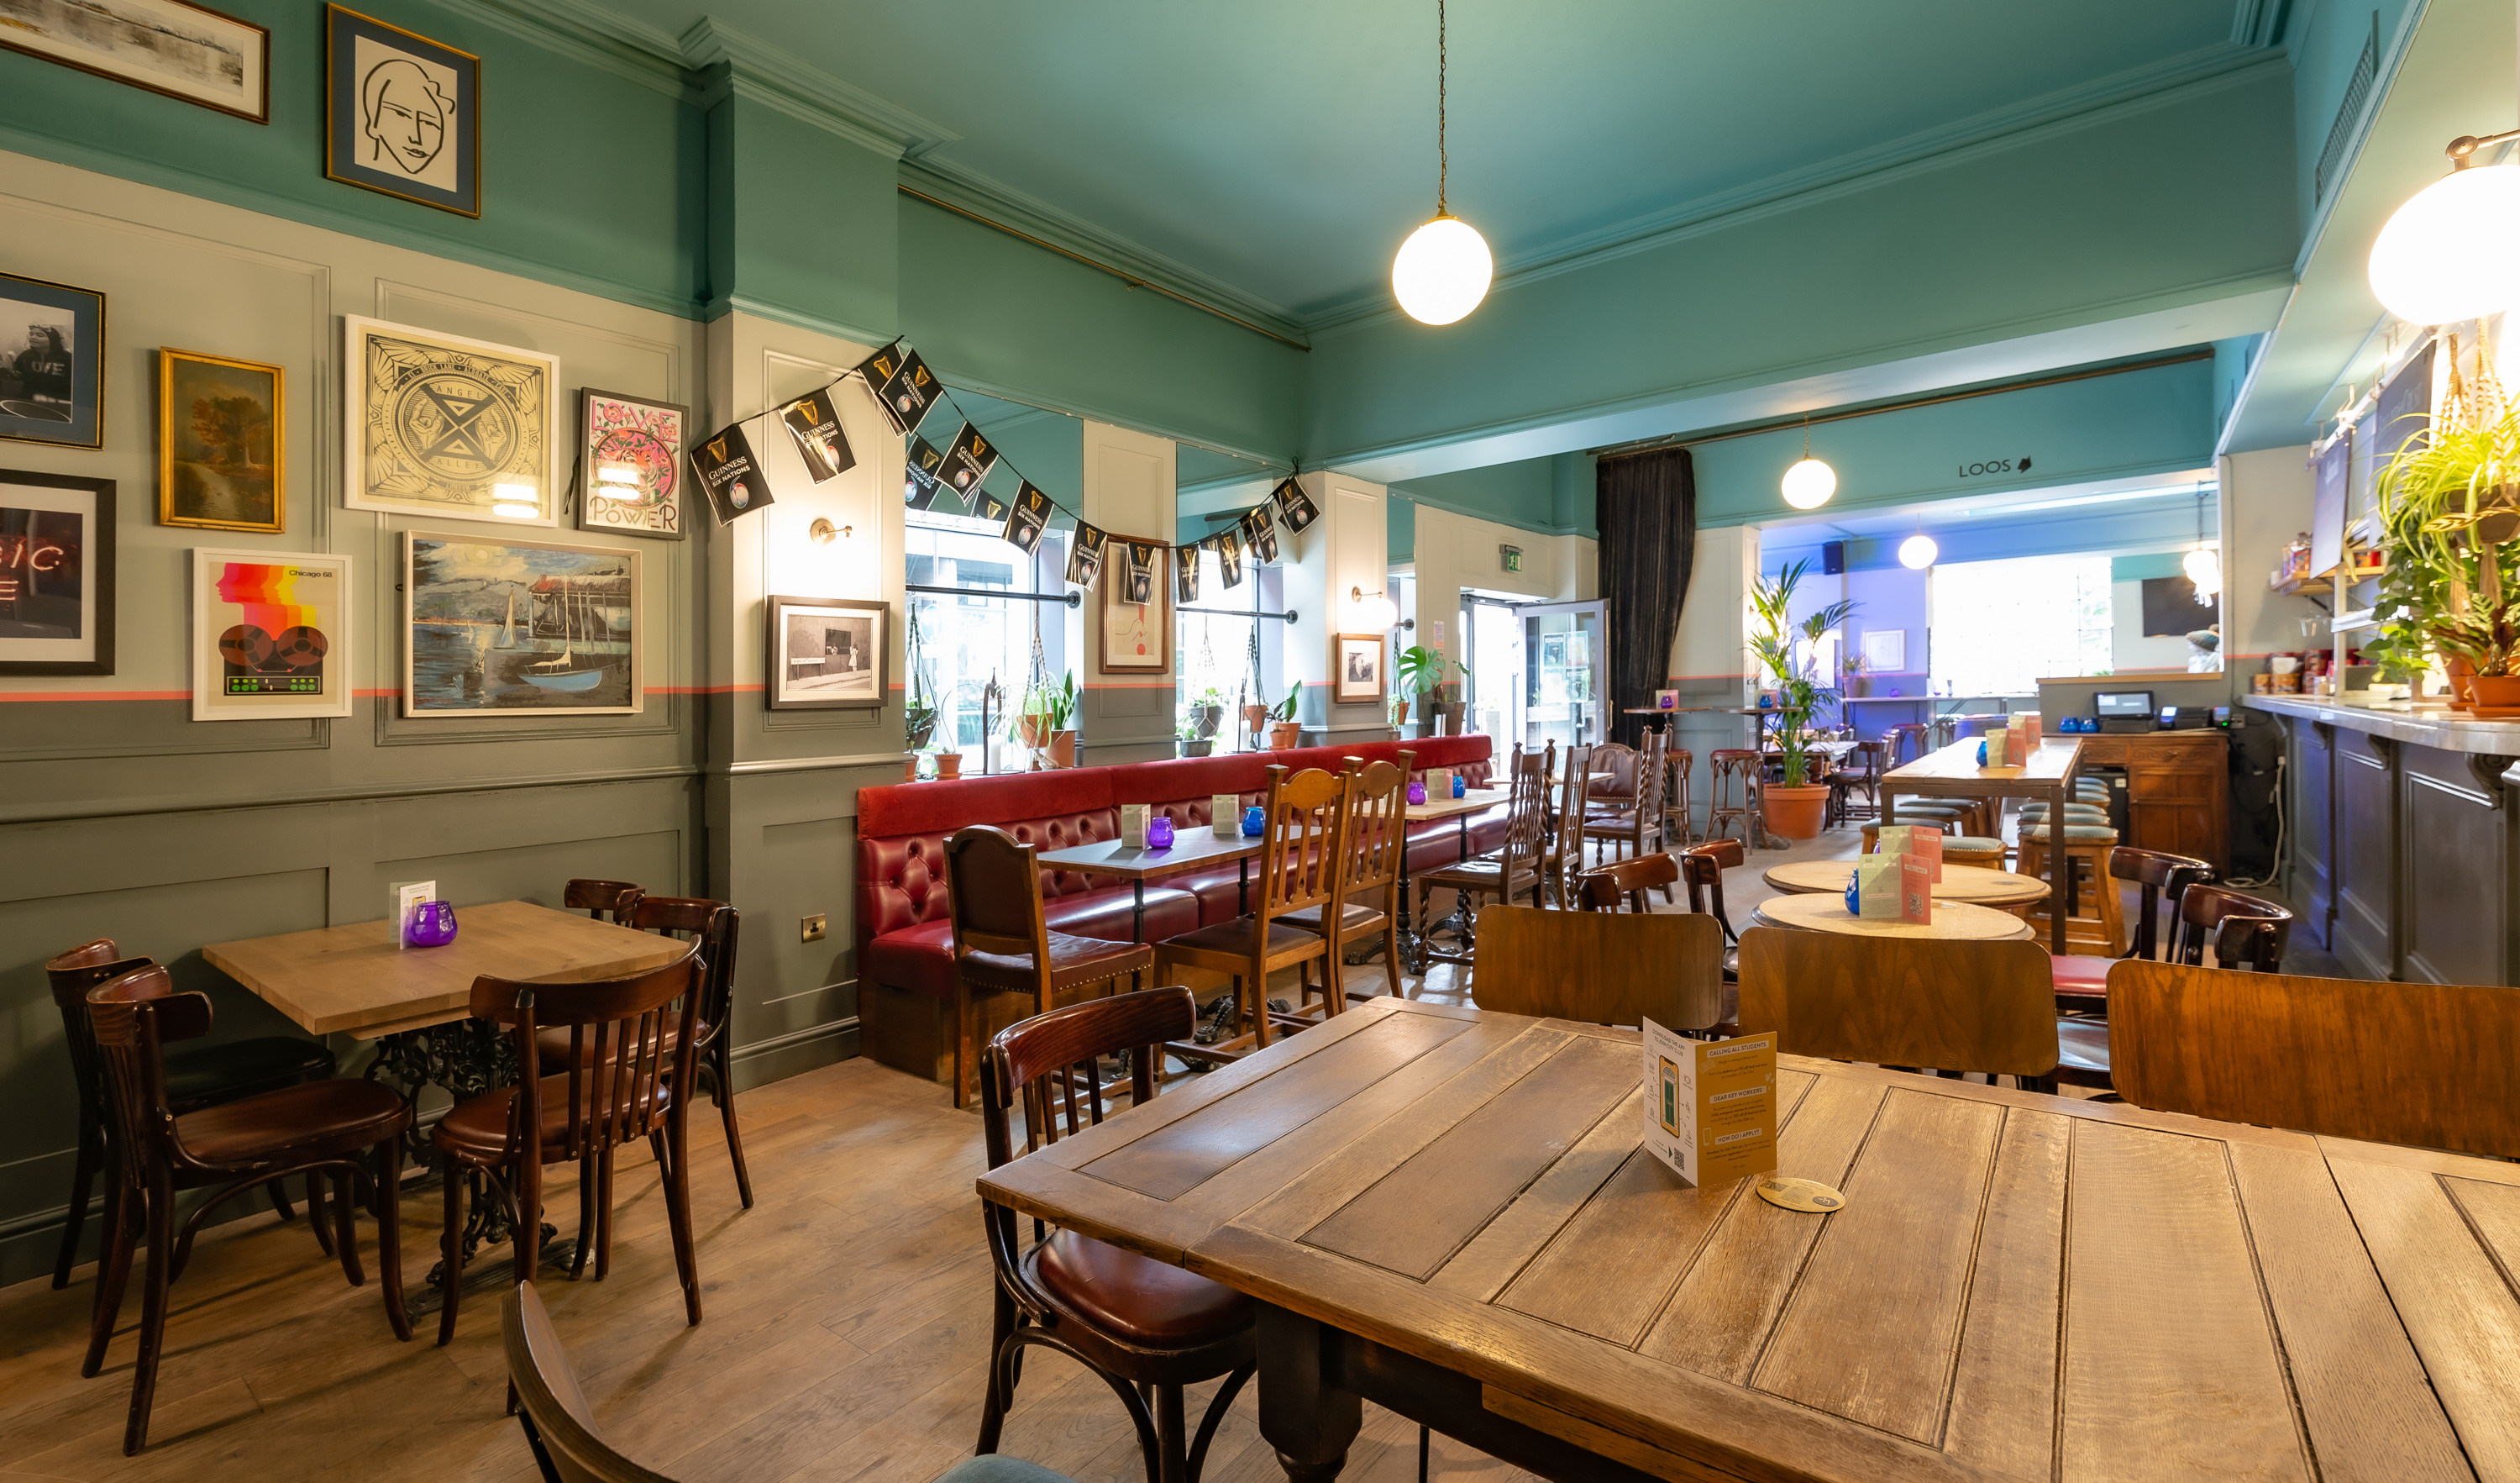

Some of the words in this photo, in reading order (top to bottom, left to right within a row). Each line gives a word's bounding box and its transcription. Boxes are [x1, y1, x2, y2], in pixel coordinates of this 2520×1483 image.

[31, 361, 65, 376] OVE
[420, 363, 437, 373] BRICK
[437, 385, 482, 400] ANGEL
[904, 371, 926, 404] GUINNESS
[907, 385, 922, 408] NATIONS
[592, 400, 679, 444] LOVE
[801, 420, 835, 440] GUINNESS
[816, 429, 838, 442] ATIONS
[437, 459, 479, 469] ALLEY
[959, 445, 984, 472] GUINNESS
[708, 455, 748, 481] GUINNESS
[964, 459, 981, 477] NATIONS
[1959, 459, 2011, 477] LOOS
[712, 479, 722, 487] SIX
[722, 465, 751, 482] NATIONS
[446, 482, 470, 491] LONDON
[1285, 494, 1302, 509] GUINNESS
[590, 495, 677, 531] POWER
[1020, 504, 1043, 524] GUINNESS
[1025, 516, 1041, 531] NATIONS
[0, 544, 63, 571] IC
[289, 570, 321, 578] Chicago
[1652, 1028, 1672, 1043] DOWNLOAD
[1675, 1048, 1683, 1056] CLUB
[1709, 1048, 1730, 1056] CALLING
[1740, 1042, 1767, 1051] STUDENTS
[1739, 1087, 1762, 1096] WORKERS
[1742, 1129, 1759, 1138] APPLY?
